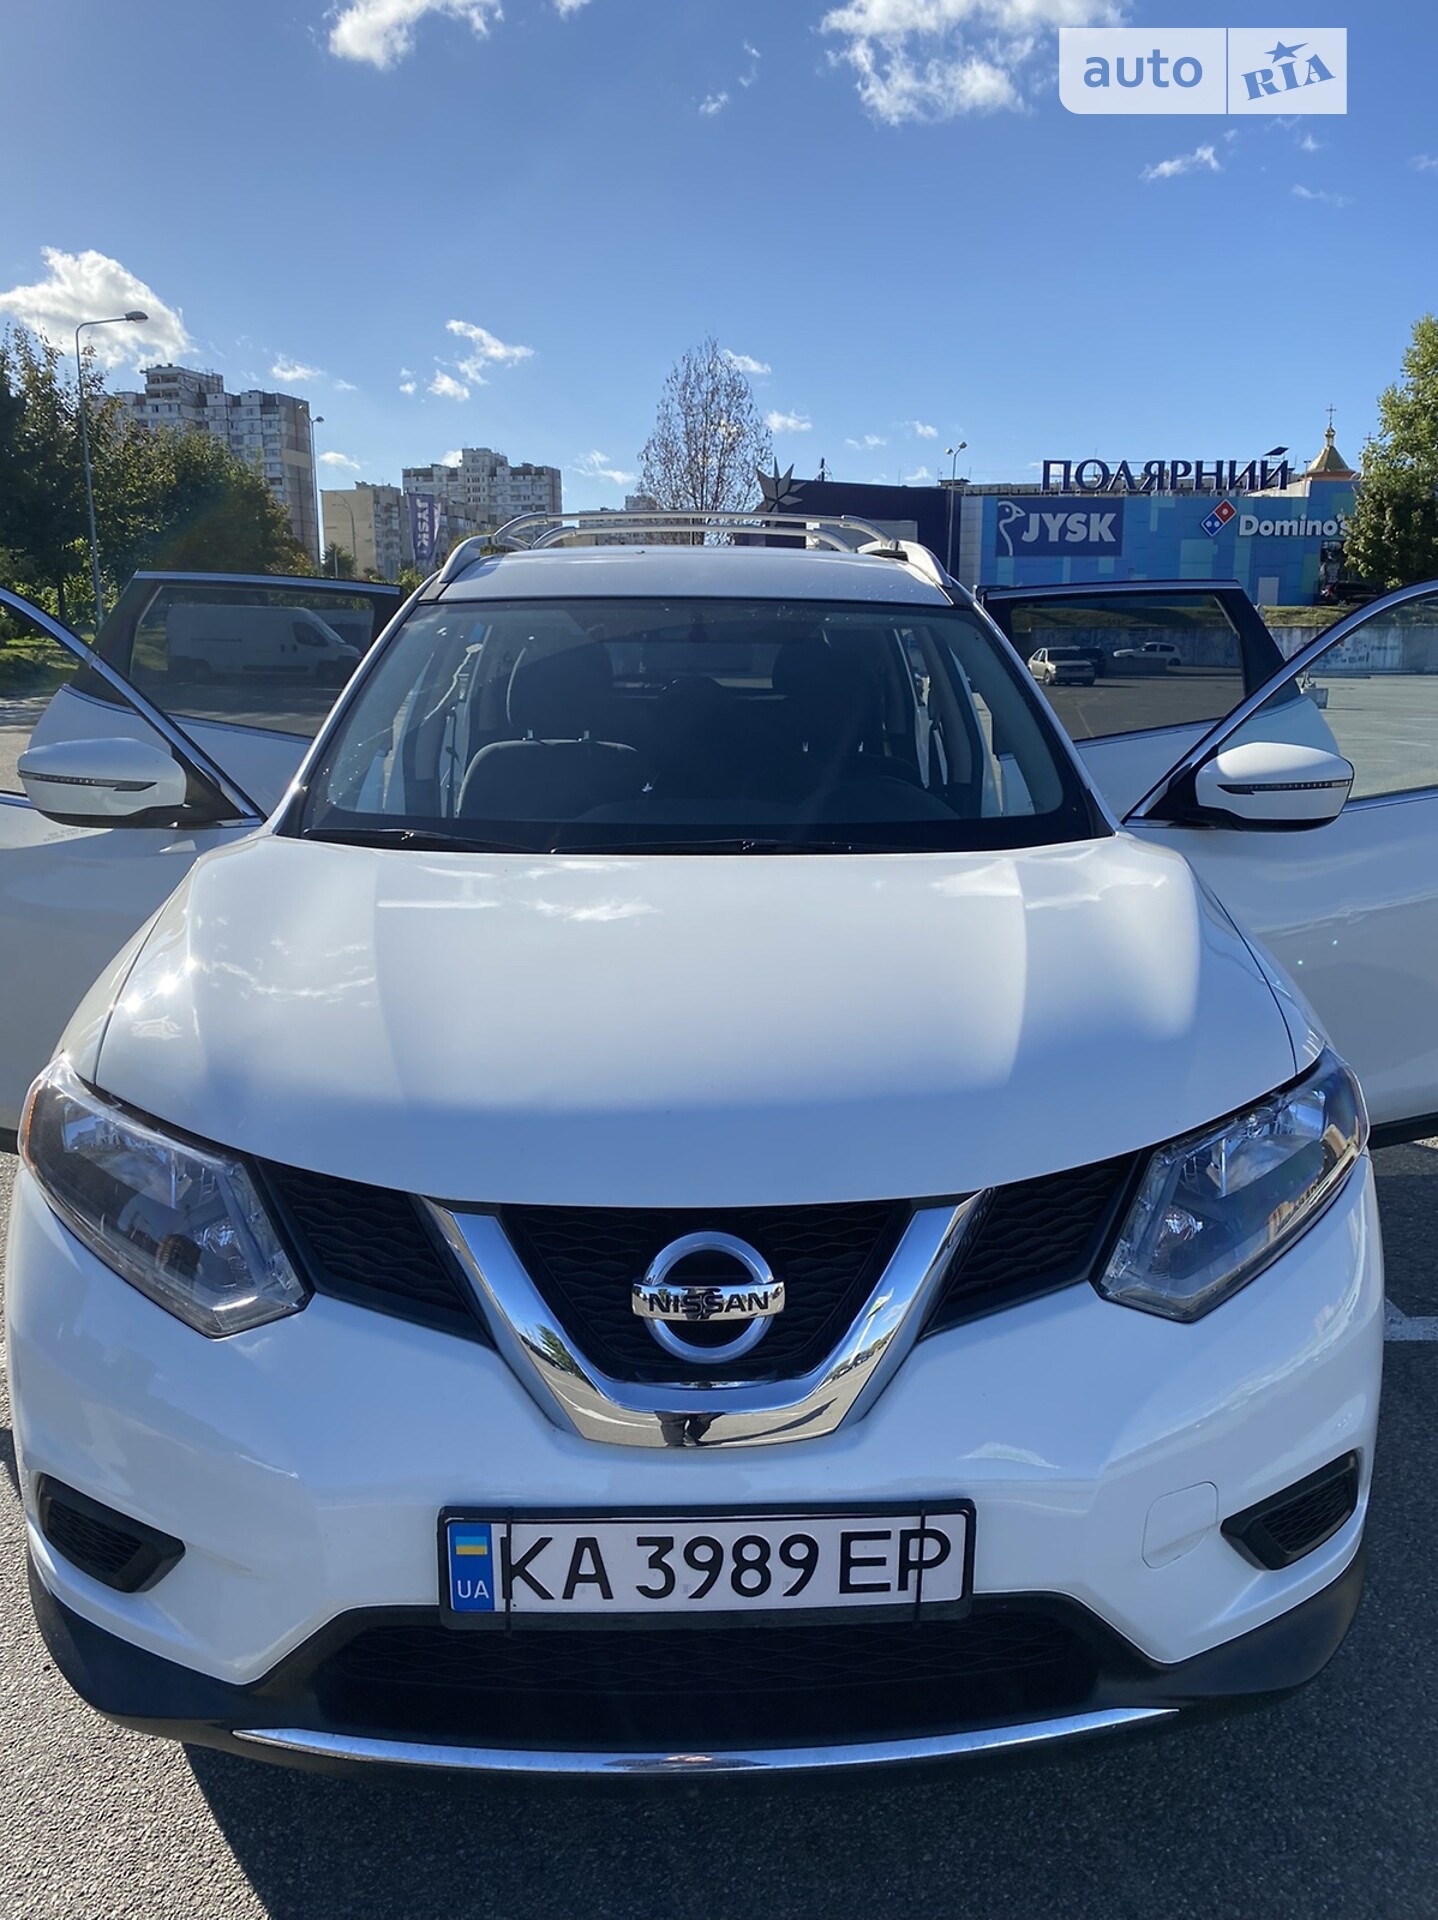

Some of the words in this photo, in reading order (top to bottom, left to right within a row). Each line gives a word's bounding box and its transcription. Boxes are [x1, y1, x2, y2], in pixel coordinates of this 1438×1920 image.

[1041, 446, 1289, 491] ПОЛЯРНИЙ
[416, 498, 429, 547] JYSK
[1021, 512, 1117, 543] JYSK
[649, 1291, 769, 1314] NISSAN
[500, 1536, 615, 1600] KA
[635, 1534, 820, 1599] 3989
[839, 1527, 951, 1594] EP
[457, 1579, 489, 1599] UA
